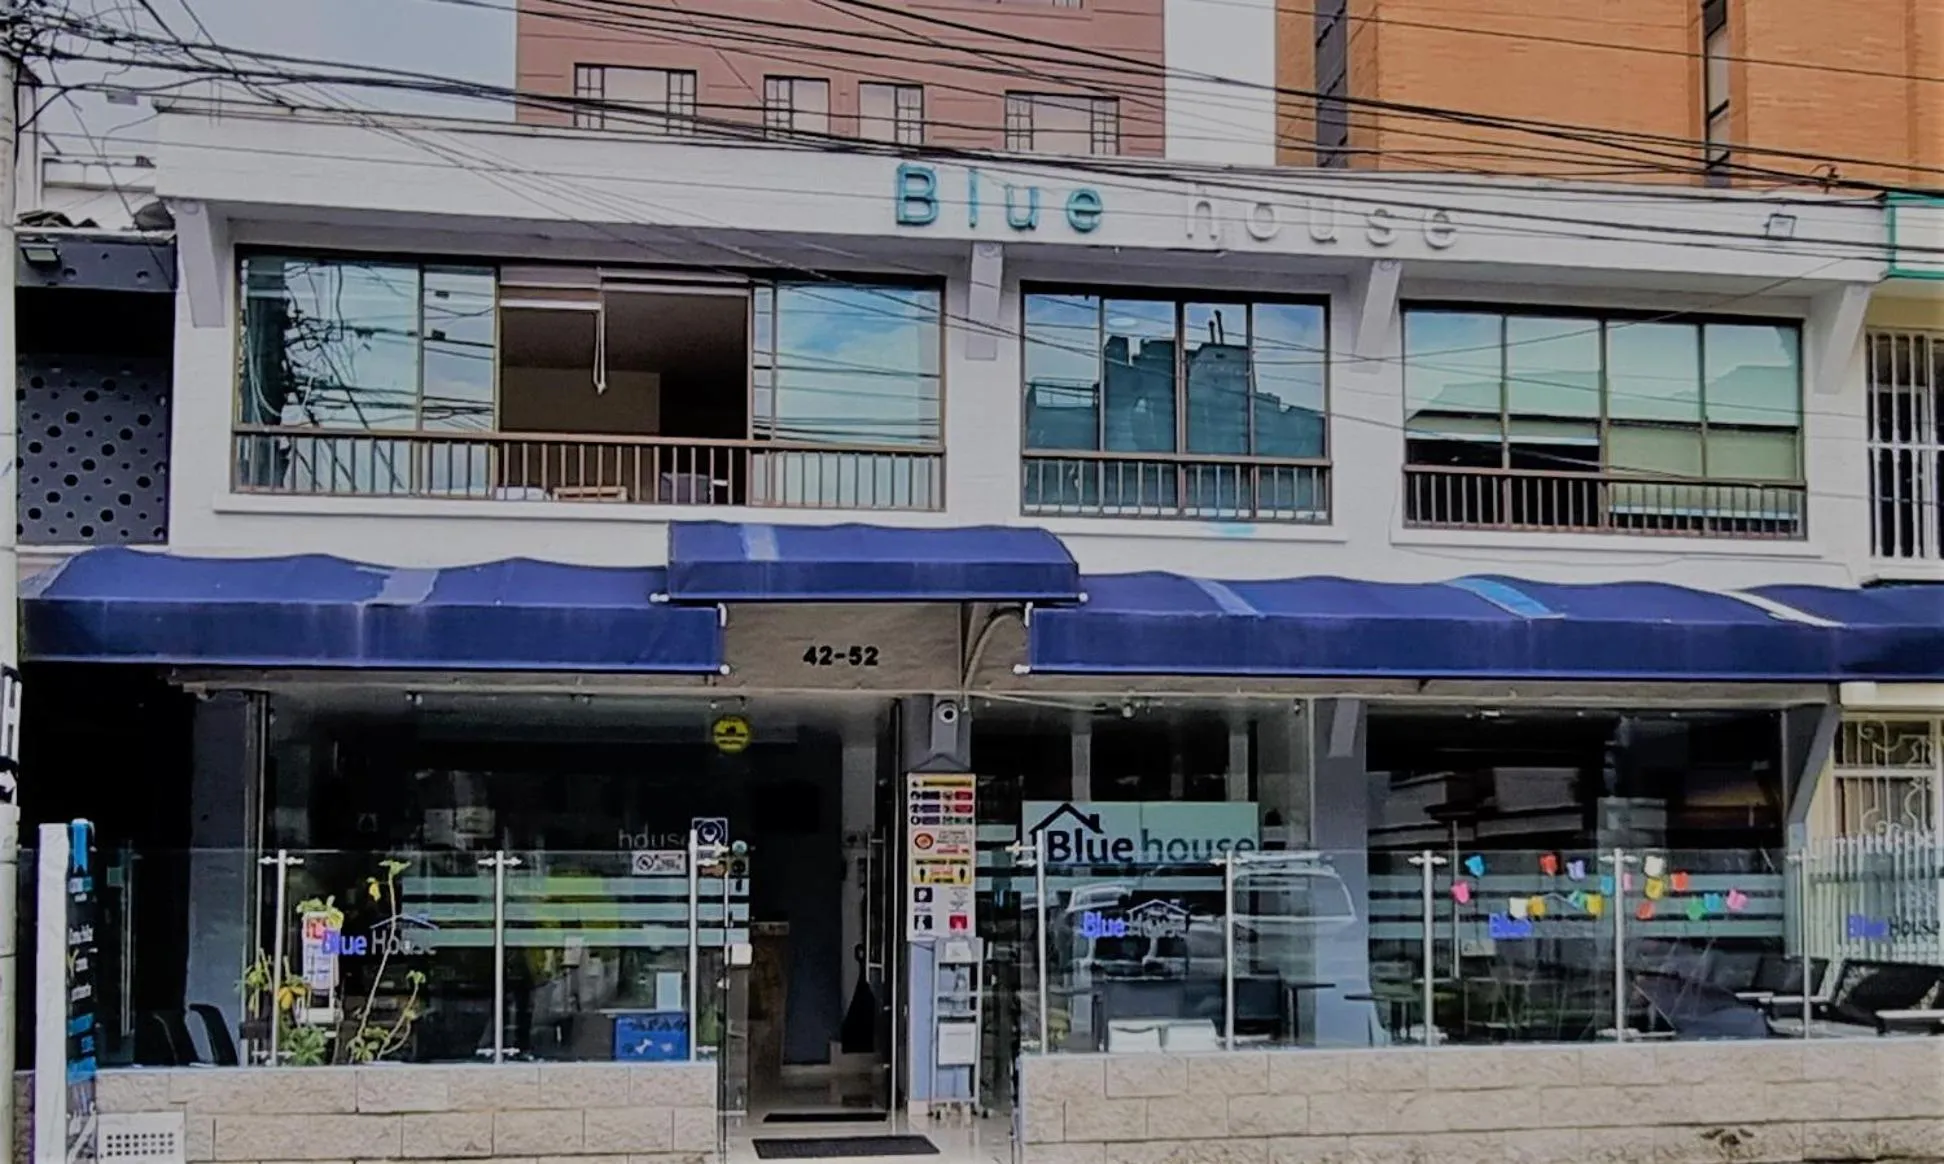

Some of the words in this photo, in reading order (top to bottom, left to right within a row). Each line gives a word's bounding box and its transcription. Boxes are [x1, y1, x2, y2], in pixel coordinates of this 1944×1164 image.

[895, 160, 1103, 234] Blue
[1184, 178, 1460, 249] house
[803, 645, 879, 667] 42-52
[1047, 828, 1134, 863] Blue
[1141, 828, 1256, 863] house
[1083, 911, 1126, 938] Blue
